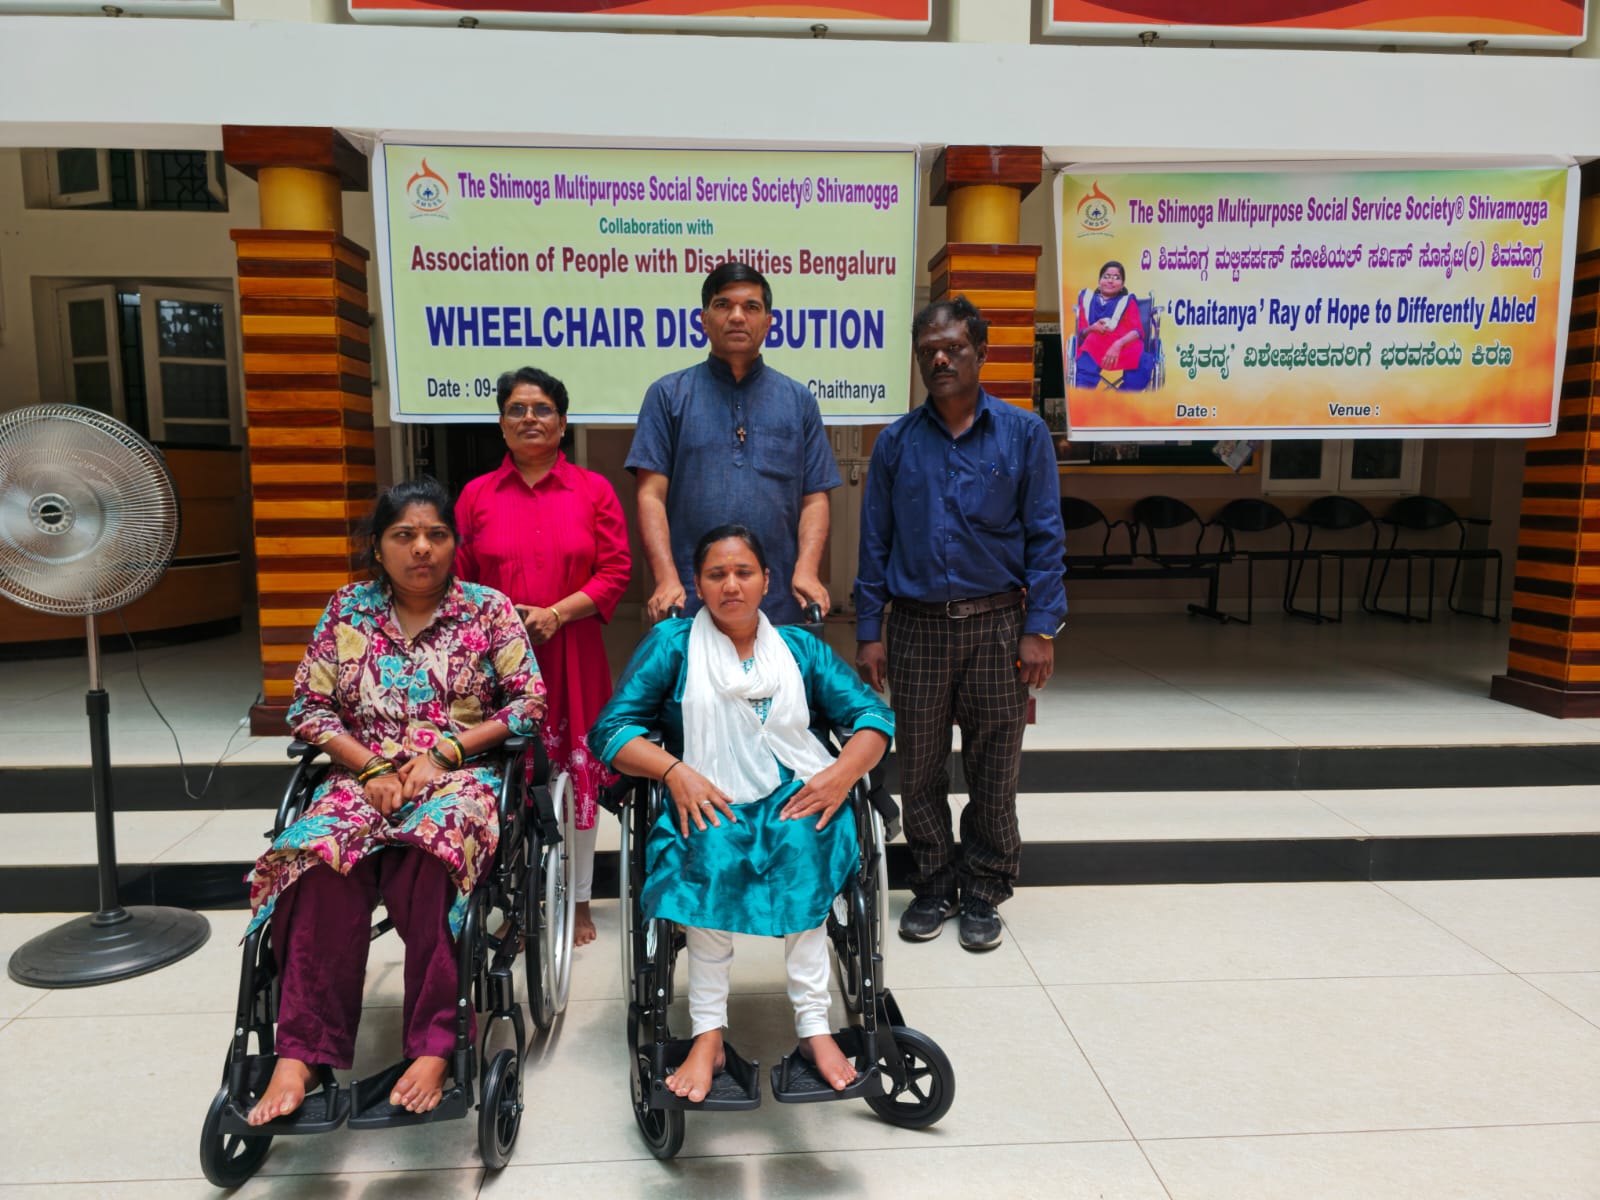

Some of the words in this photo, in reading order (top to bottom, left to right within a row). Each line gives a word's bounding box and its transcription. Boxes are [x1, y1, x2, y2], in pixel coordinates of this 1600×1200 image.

[457, 171, 486, 199] The
[489, 171, 551, 206] Shimoga
[554, 173, 646, 206] Multipurpose
[649, 175, 693, 201] Social
[696, 176, 748, 201] Service
[816, 177, 899, 210] Shivamogga
[599, 217, 683, 235] Collaboration
[686, 219, 714, 236] with
[1128, 199, 1154, 224] The
[1158, 199, 1213, 229] Shimoga
[1217, 199, 1303, 231] Multipurpose
[1307, 198, 1349, 222] Social
[1352, 197, 1402, 222] Service
[1468, 195, 1548, 226] Shivamogga
[411, 245, 529, 273] Association
[535, 246, 556, 272] of
[562, 246, 629, 279] People
[635, 247, 678, 273] with
[799, 249, 897, 281] Bengaluru
[1141, 249, 1152, 271] ದಿ
[1158, 245, 1209, 282] ಶಿವಮೊಗ್ಗ
[1215, 244, 1285, 282] ಮಲ್ಟಿಪರ್ಪಸ್
[1290, 243, 1362, 270] ಸೋಶಿಯಲ್
[1368, 243, 1413, 269] ಸರ್ವಿಸ್
[1490, 241, 1544, 278] ಶಿವಮೊಗ್ಗ
[425, 306, 645, 347] WHEELCHAIR
[656, 308, 884, 349] DISBUTION
[1269, 300, 1301, 330] Ray
[1305, 298, 1322, 324] of
[1327, 299, 1370, 329] Hope
[1375, 301, 1392, 324] to
[1397, 297, 1483, 329] Differently
[1489, 297, 1536, 324] Abled
[1244, 342, 1372, 371] ವಿಶೇಷಚೇತನರಿಗೆ
[1380, 341, 1463, 369] ಭರವಸೆಯ
[1471, 341, 1513, 367] ಕಿರಣ
[427, 378, 460, 398] Date
[465, 382, 470, 398] :
[807, 379, 886, 404] Chaithanya
[1176, 405, 1209, 418] Date
[1329, 404, 1372, 418] Venue
